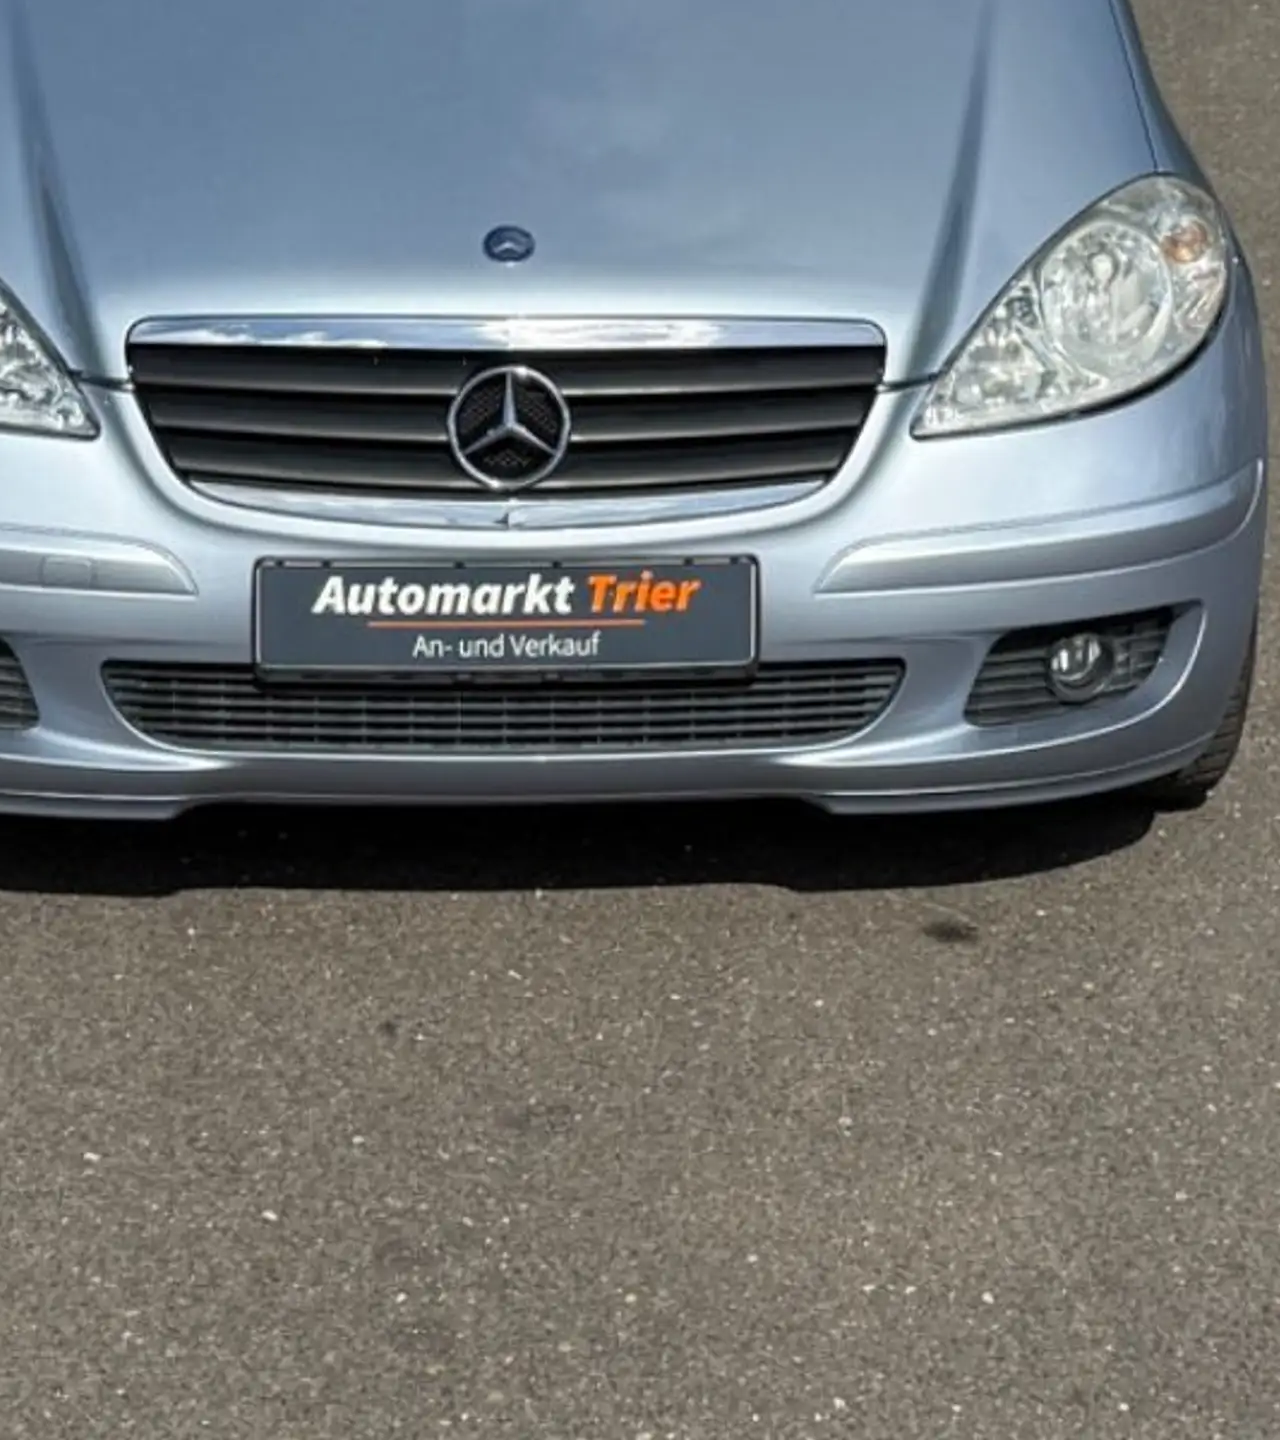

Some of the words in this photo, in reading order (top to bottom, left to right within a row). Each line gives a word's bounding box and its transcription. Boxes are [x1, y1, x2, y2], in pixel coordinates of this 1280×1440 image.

[311, 573, 576, 616] Automarkt
[587, 571, 702, 614] Trier
[412, 636, 453, 659] An-
[459, 634, 504, 659] und
[509, 630, 601, 659] Verkauf
